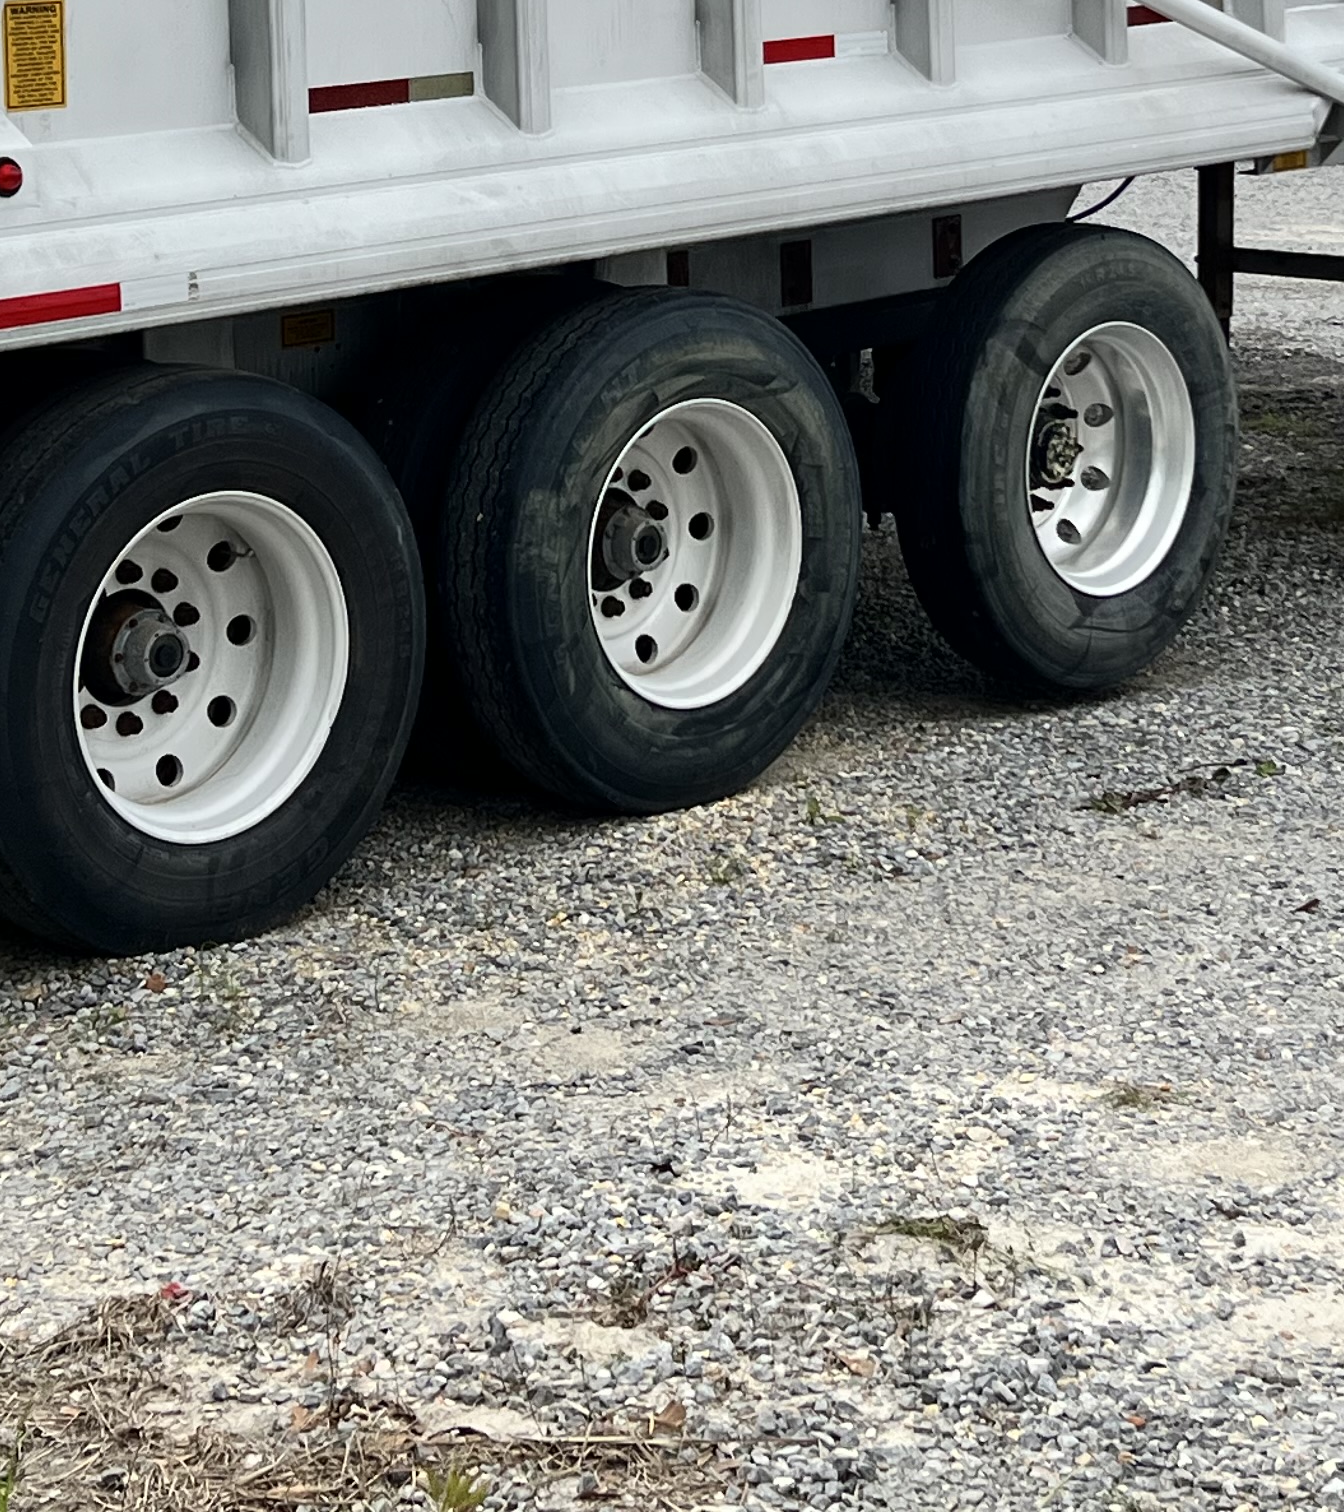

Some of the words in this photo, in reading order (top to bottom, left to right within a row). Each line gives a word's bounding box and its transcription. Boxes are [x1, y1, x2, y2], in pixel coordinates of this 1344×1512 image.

[10, 5, 56, 14] WARNING
[29, 452, 152, 624] GENERAL
[174, 415, 249, 450] TIRE
